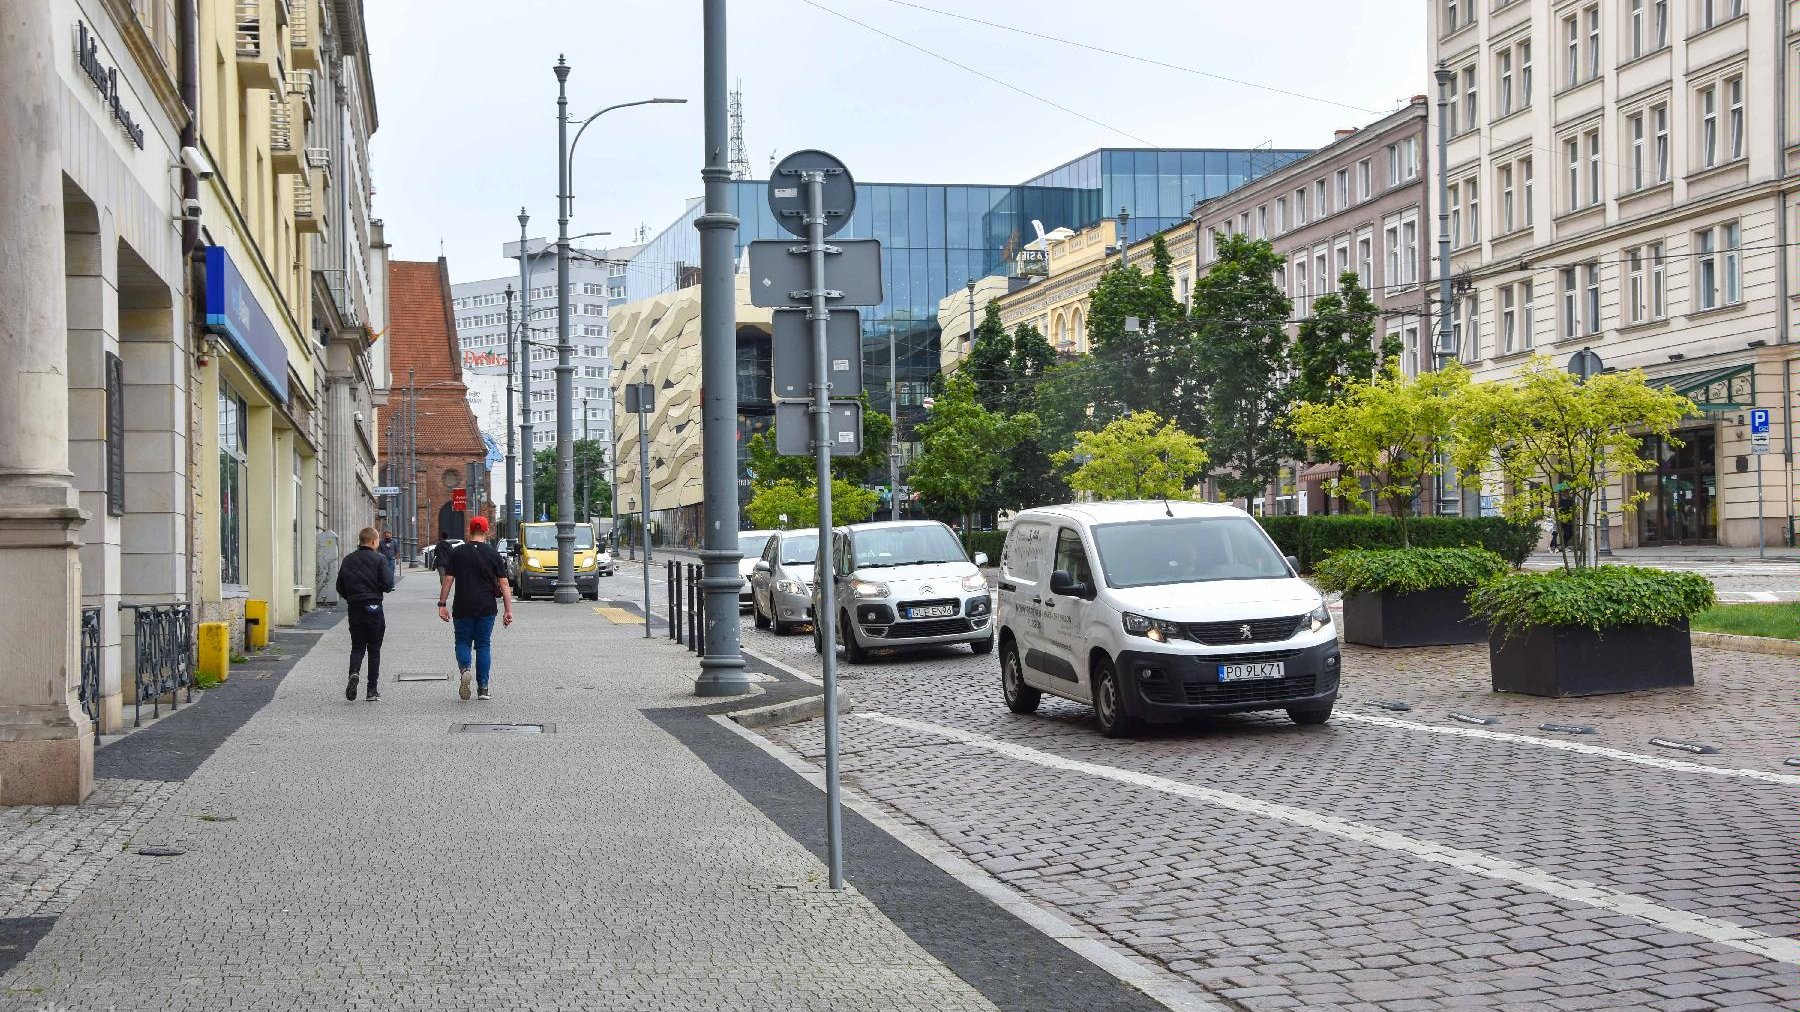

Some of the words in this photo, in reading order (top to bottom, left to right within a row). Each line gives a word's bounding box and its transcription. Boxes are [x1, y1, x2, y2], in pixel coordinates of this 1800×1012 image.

[1754, 411, 1766, 427] P
[1226, 666, 1242, 679] PO
[1246, 663, 1281, 677] 9LK71
